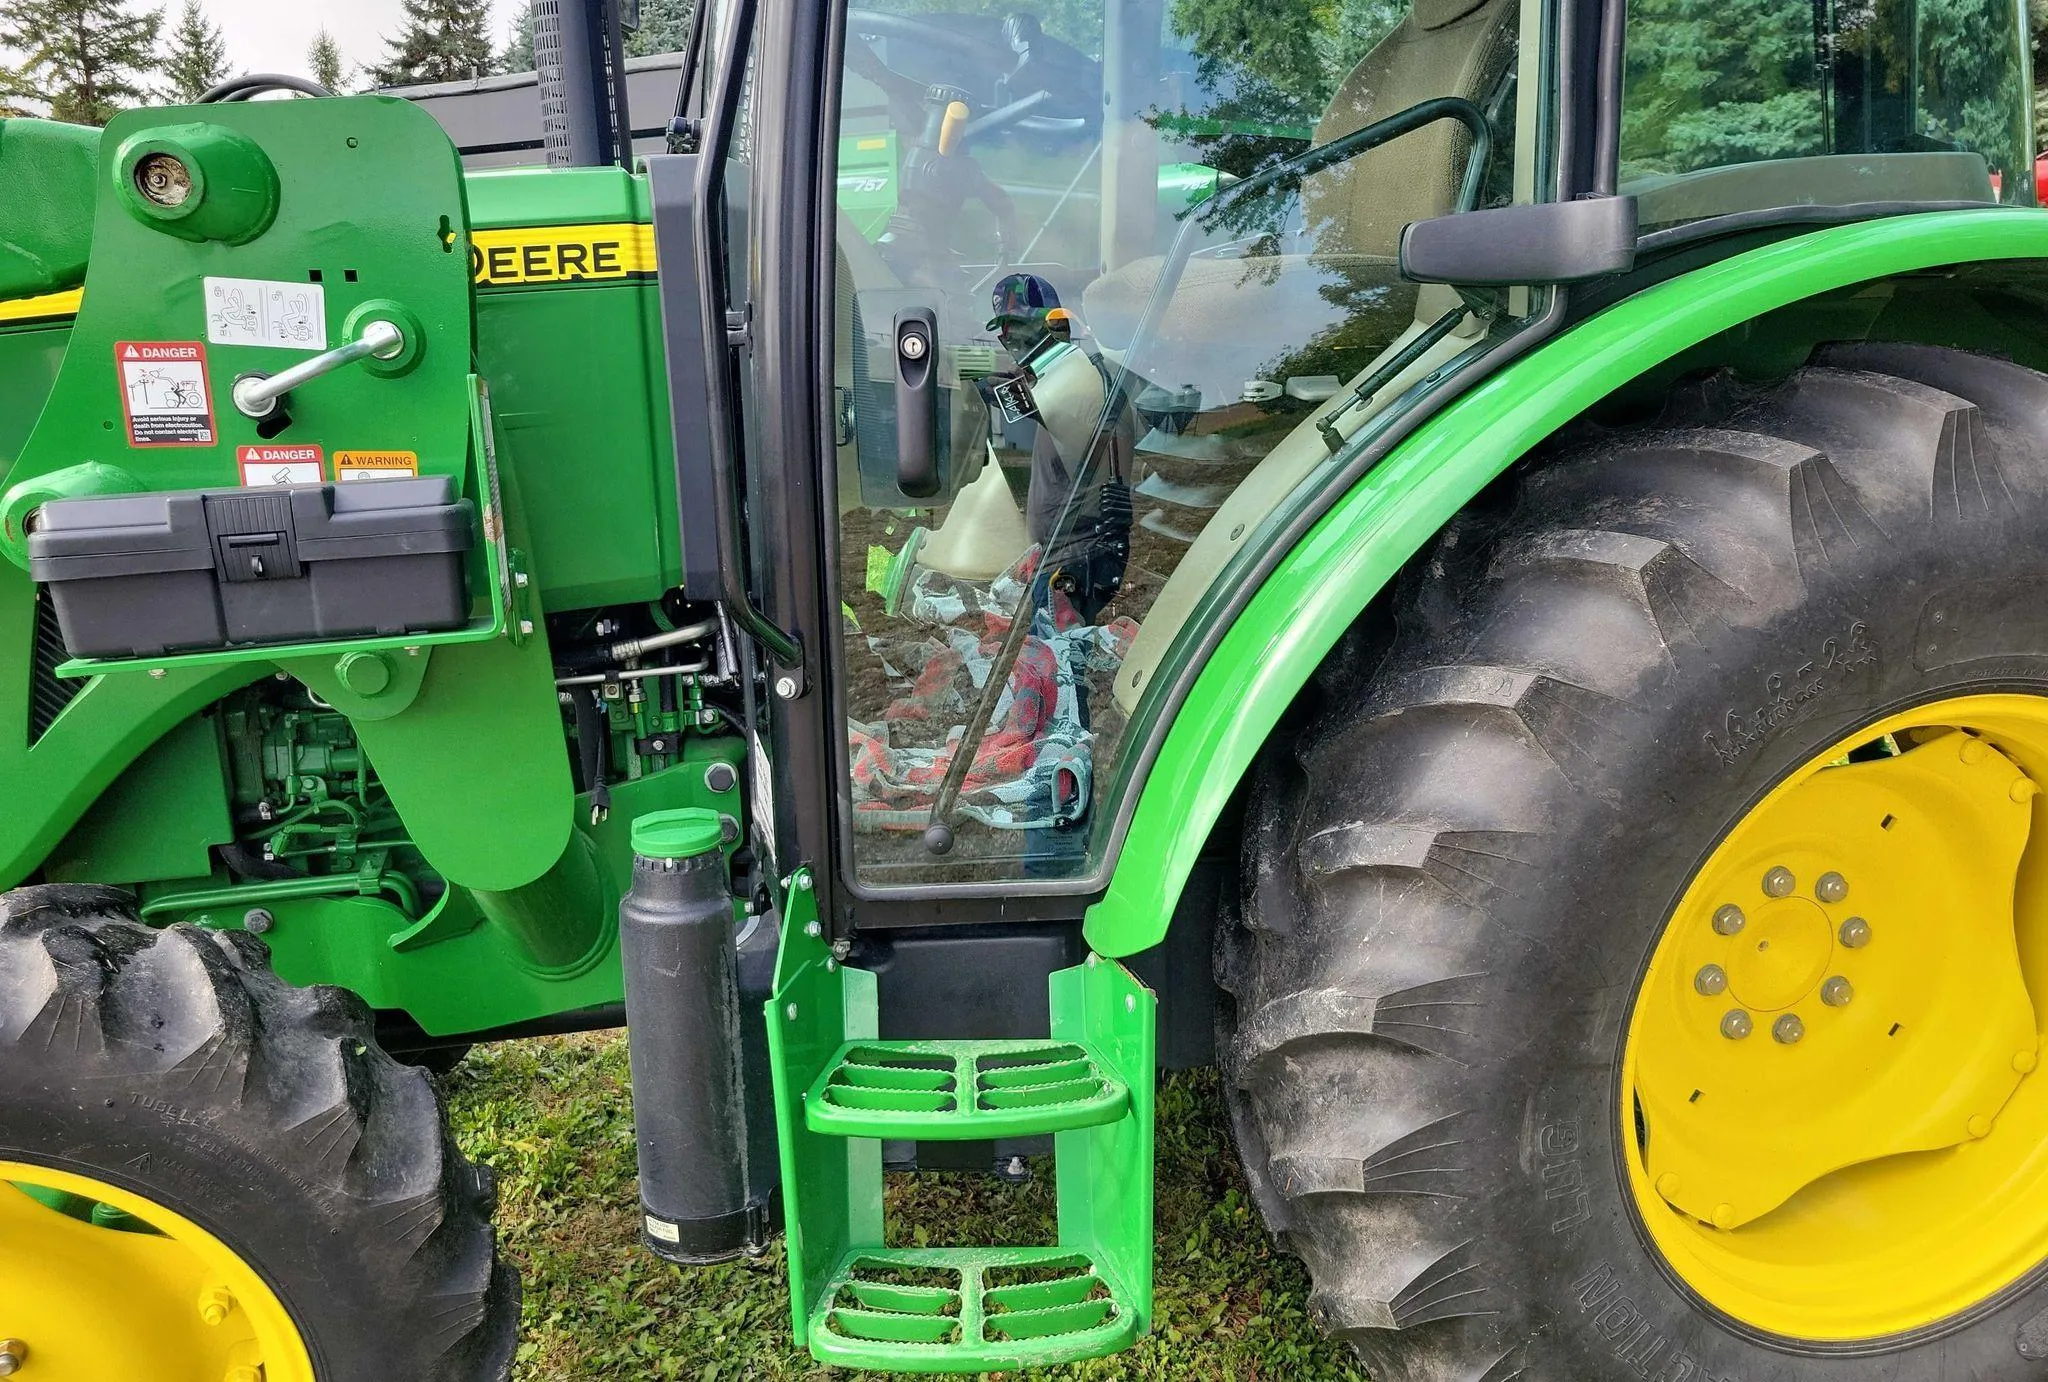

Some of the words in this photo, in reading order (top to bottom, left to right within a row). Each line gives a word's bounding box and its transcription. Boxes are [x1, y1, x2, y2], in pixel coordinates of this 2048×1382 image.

[142, 347, 197, 358] DANGER
[263, 449, 316, 461] DANGER
[355, 456, 412, 466] WARNING
[1540, 1120, 1592, 1235] LUG
[1572, 1261, 1738, 1382] CTION
